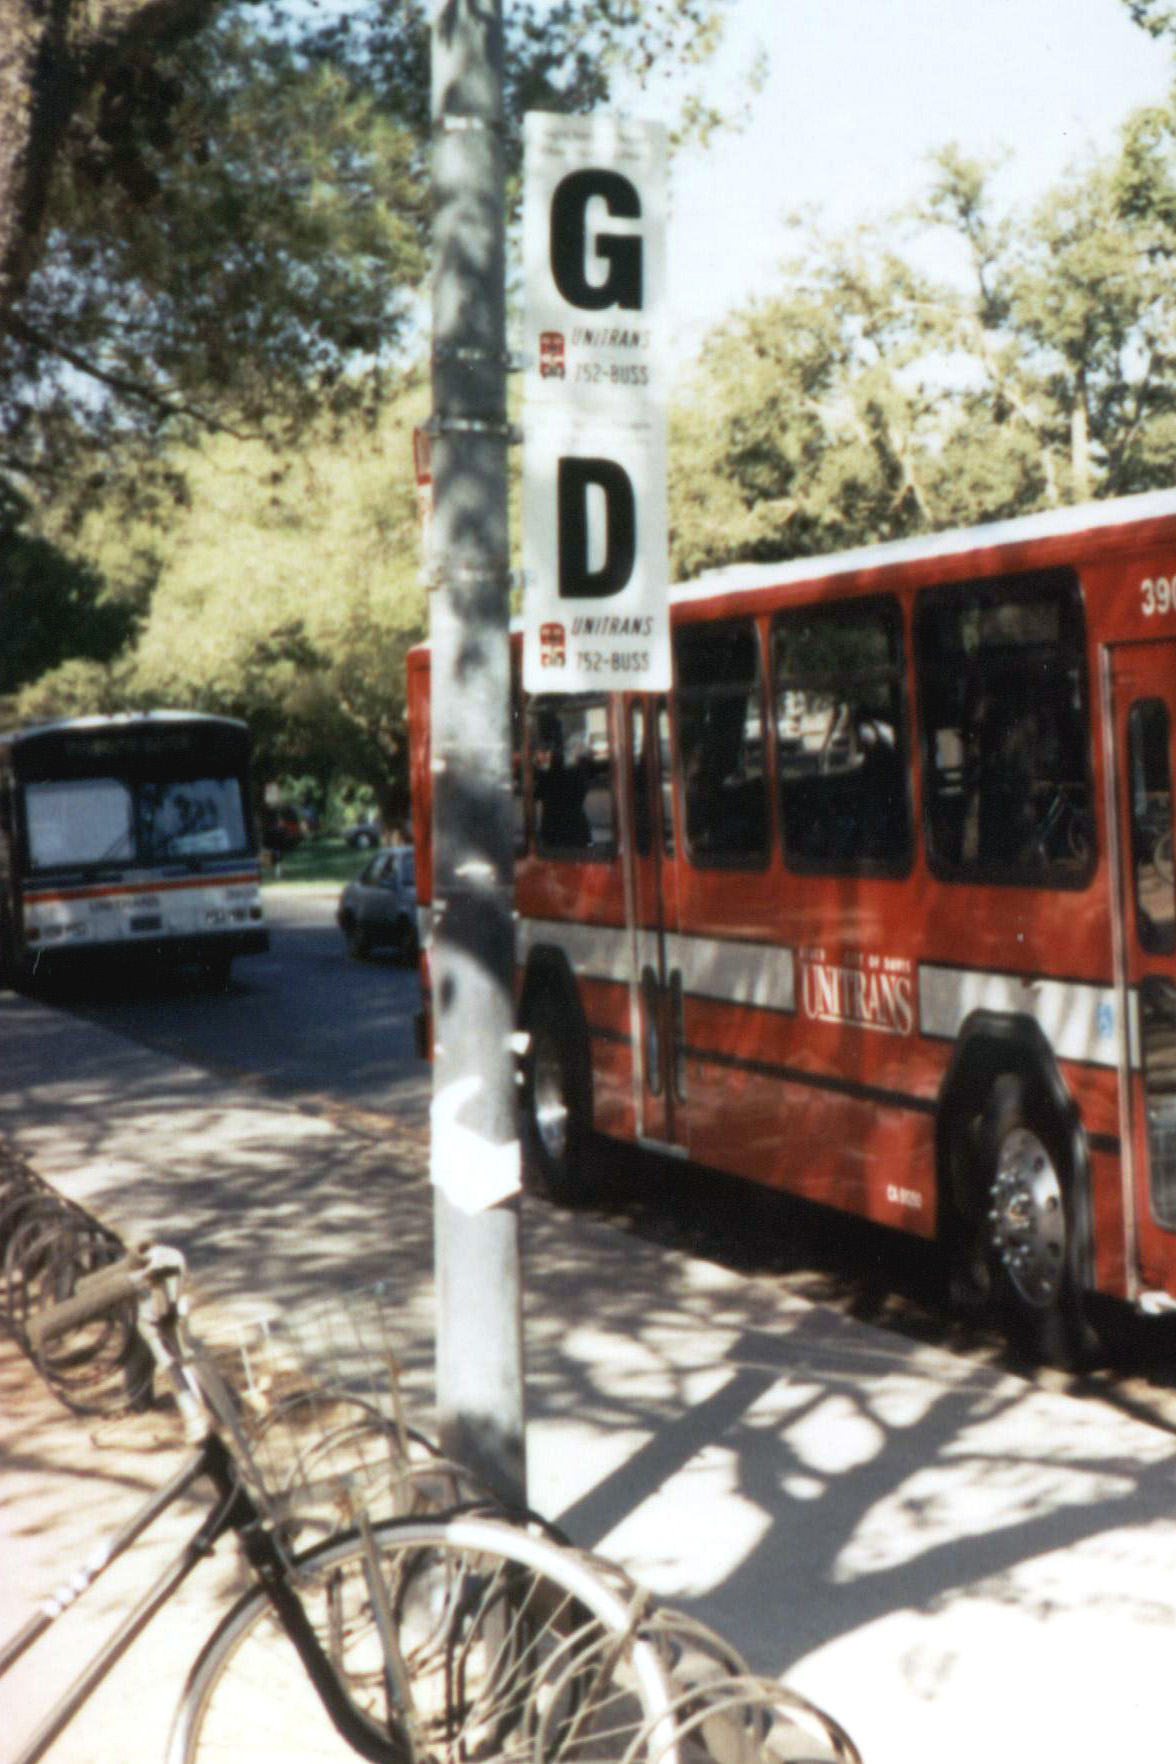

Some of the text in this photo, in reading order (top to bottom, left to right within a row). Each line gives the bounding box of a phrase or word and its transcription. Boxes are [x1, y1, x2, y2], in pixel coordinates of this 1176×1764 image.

[550, 168, 643, 311] G
[572, 328, 651, 348] UNITRANS
[558, 456, 636, 598] D
[572, 616, 653, 637] UNITRANS
[576, 651, 649, 672] 752-BUSS
[802, 965, 914, 1036] UNITRANS
